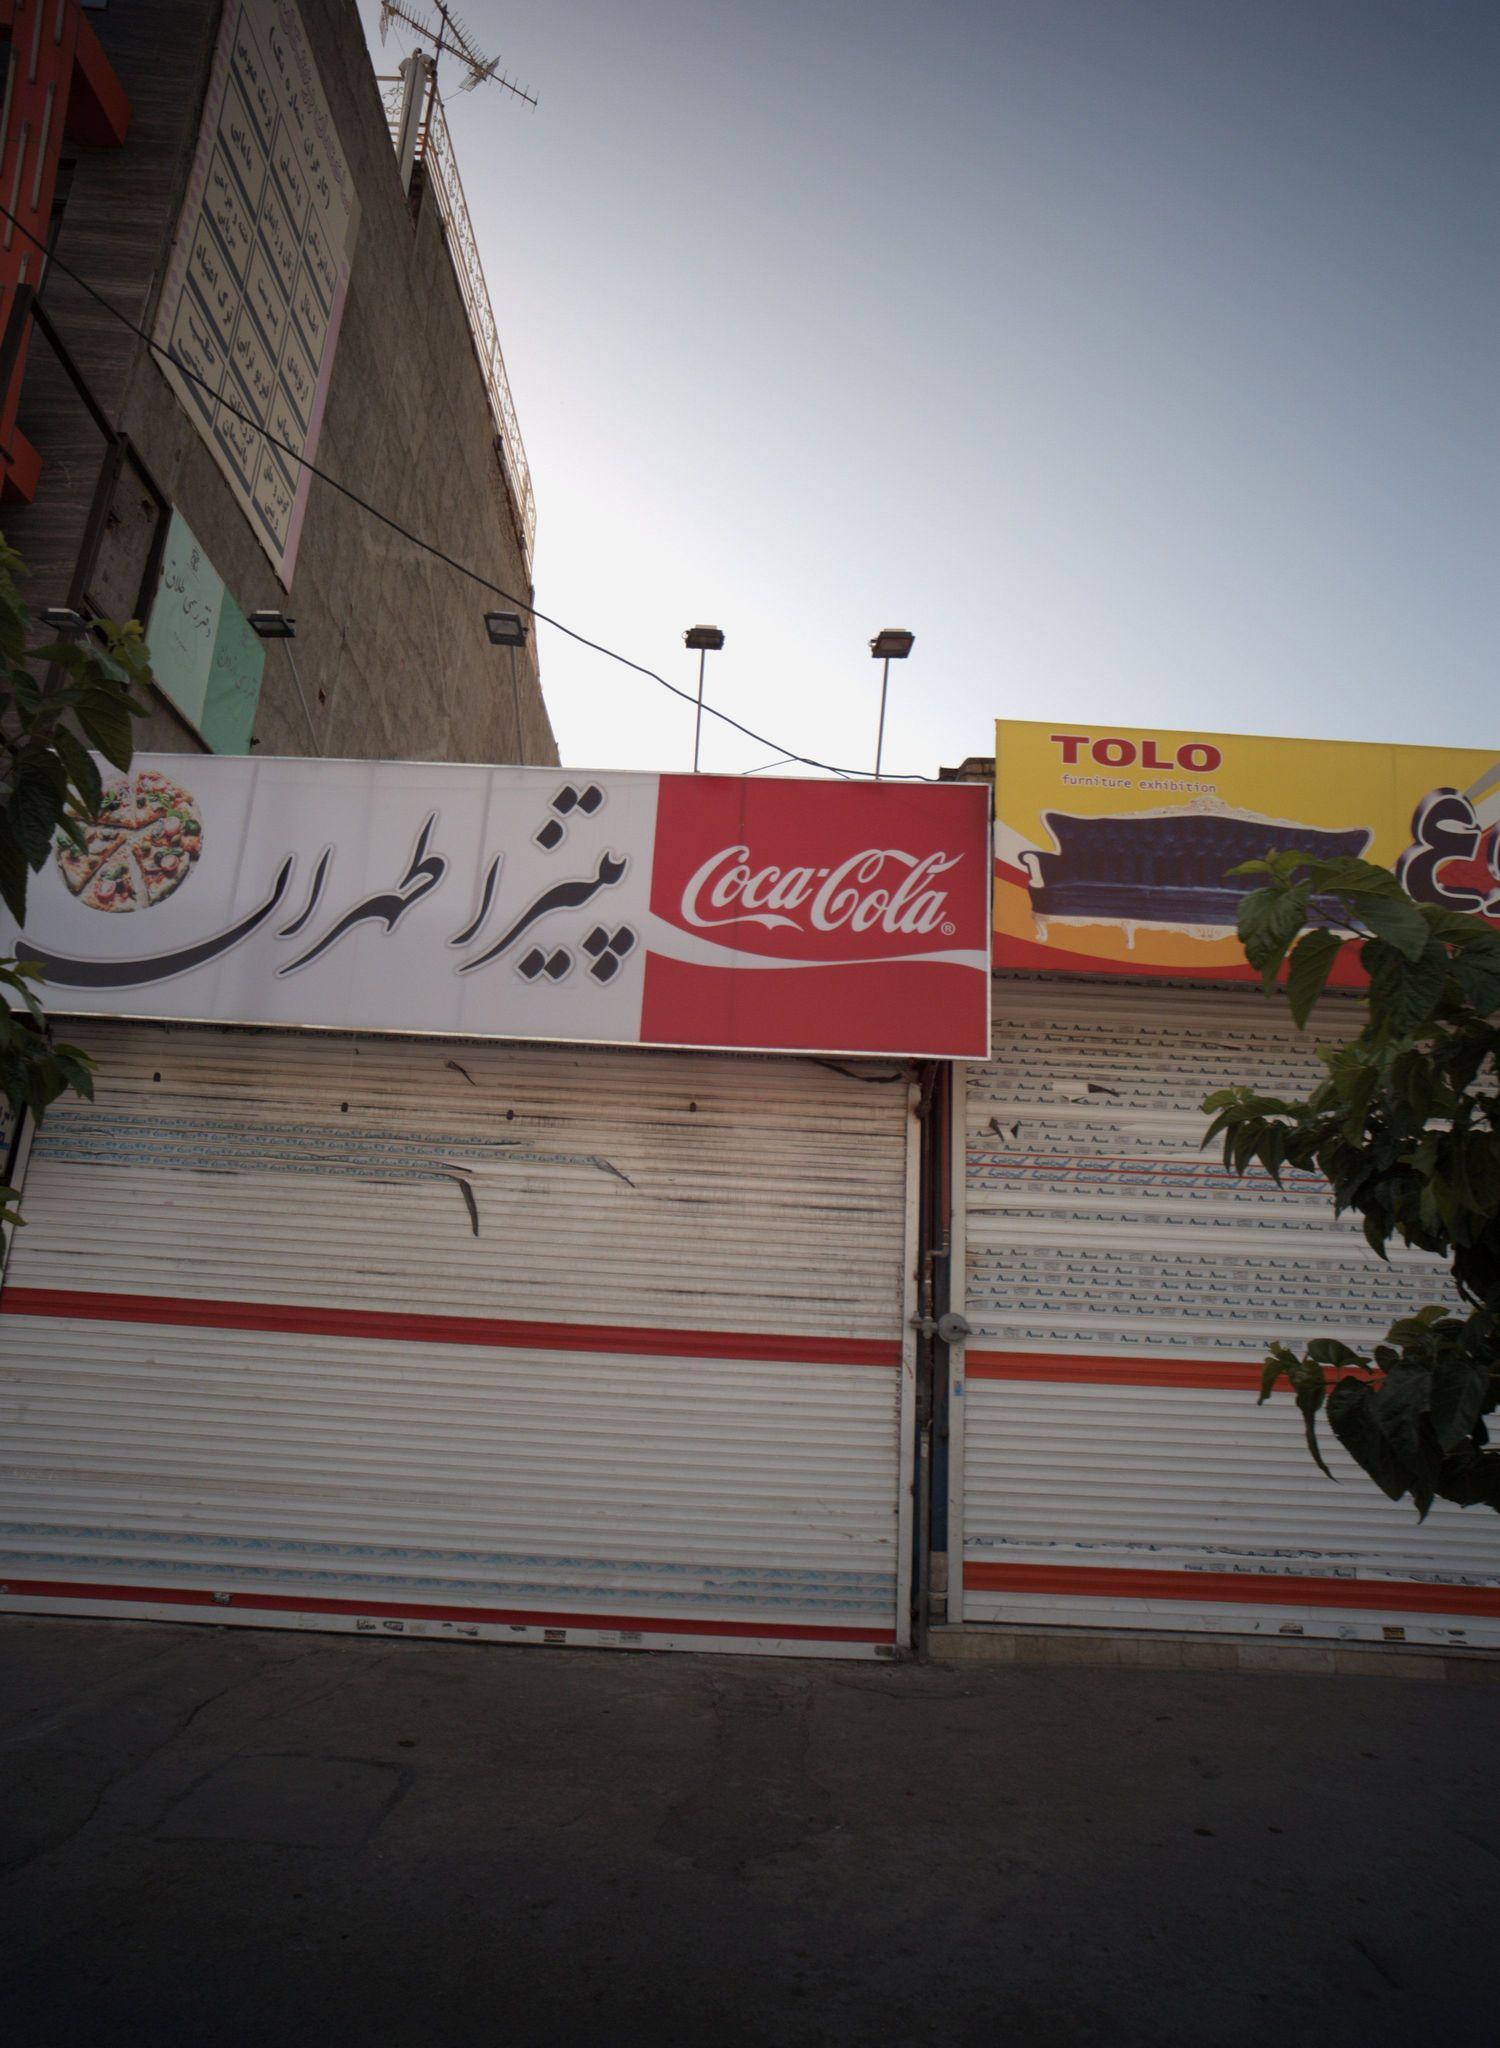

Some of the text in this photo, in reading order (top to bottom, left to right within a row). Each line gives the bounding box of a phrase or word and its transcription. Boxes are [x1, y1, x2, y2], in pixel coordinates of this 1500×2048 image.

[1050, 734, 1222, 773] TOLO
[1062, 773, 1217, 794] furniture exhibition
[448, 785, 635, 983] پیتزا
[681, 845, 965, 933] Coca-Cola
